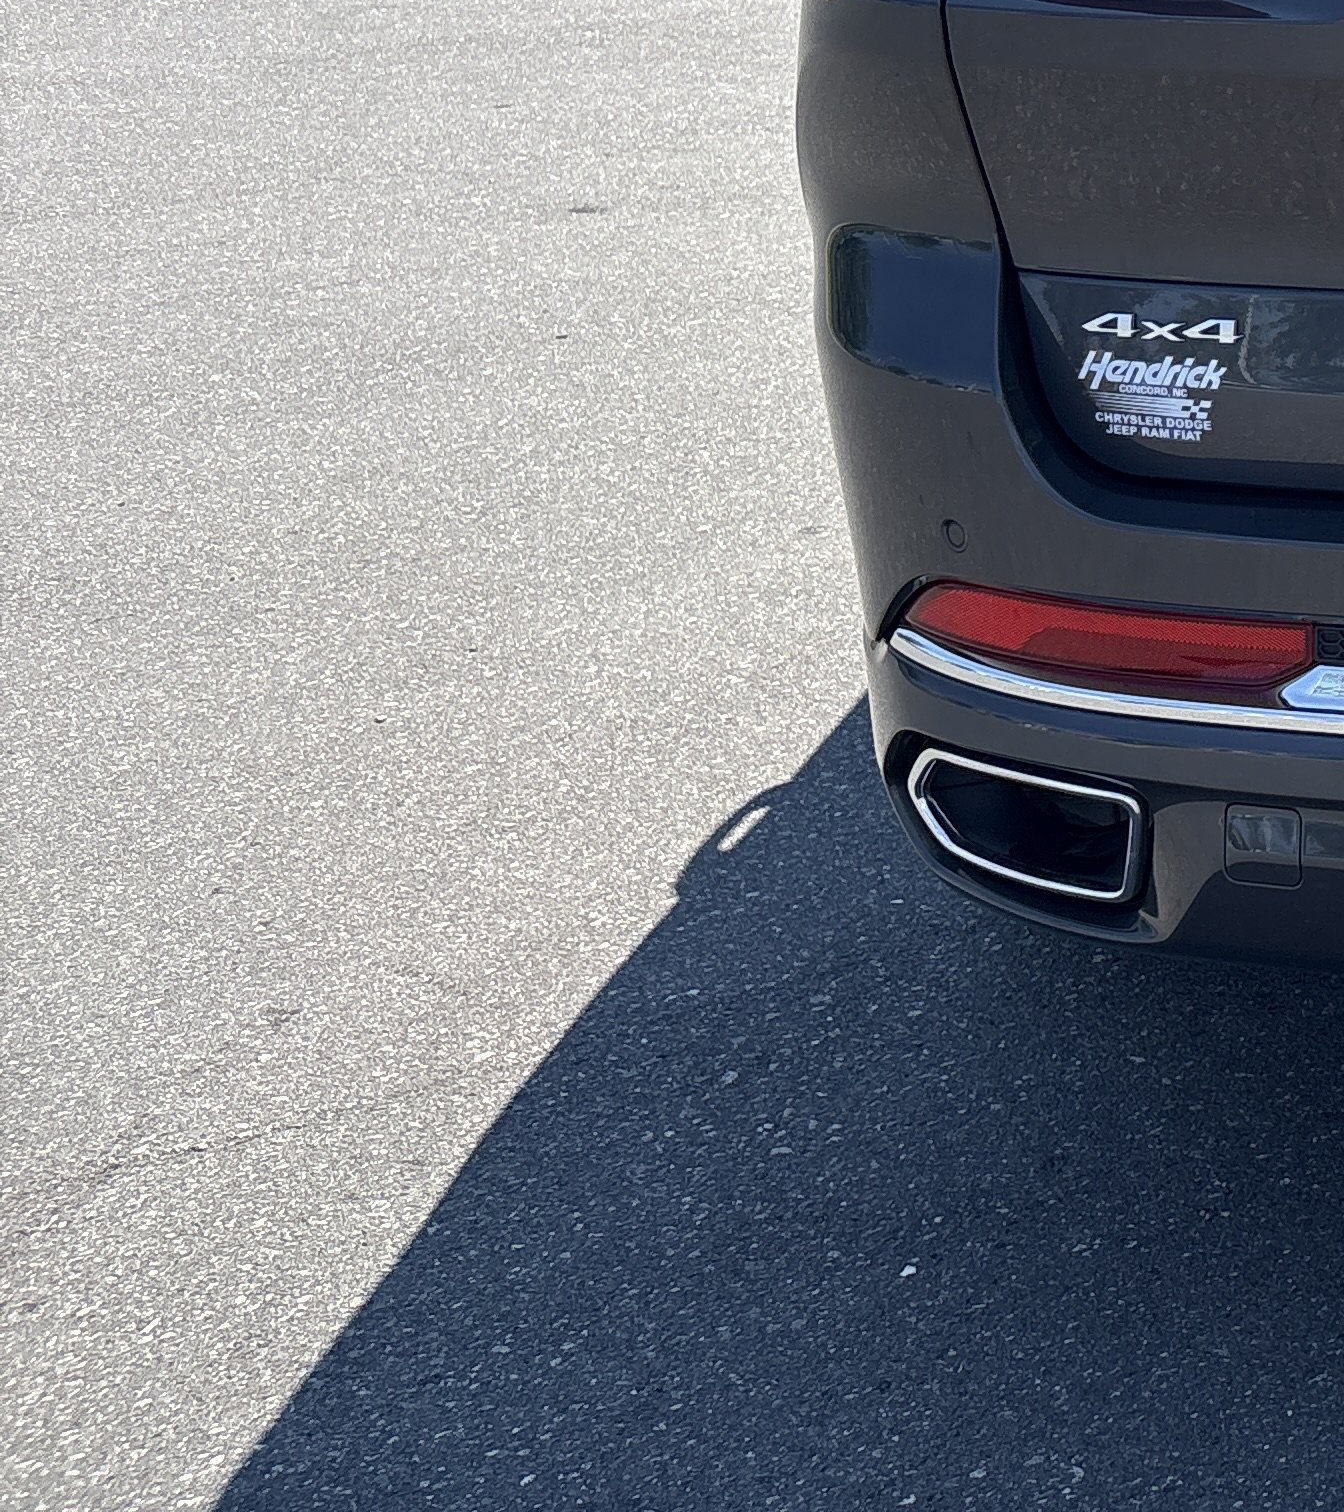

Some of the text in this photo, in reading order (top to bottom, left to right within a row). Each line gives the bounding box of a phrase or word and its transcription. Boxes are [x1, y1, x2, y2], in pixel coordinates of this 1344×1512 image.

[1081, 311, 1245, 345] 4x4
[1077, 350, 1228, 390] Hendrick
[1118, 384, 1189, 398] CONCORD, NC
[1095, 411, 1213, 431] CHRYSLER DODGE
[1105, 423, 1203, 442] JEEP RAM FIAT
